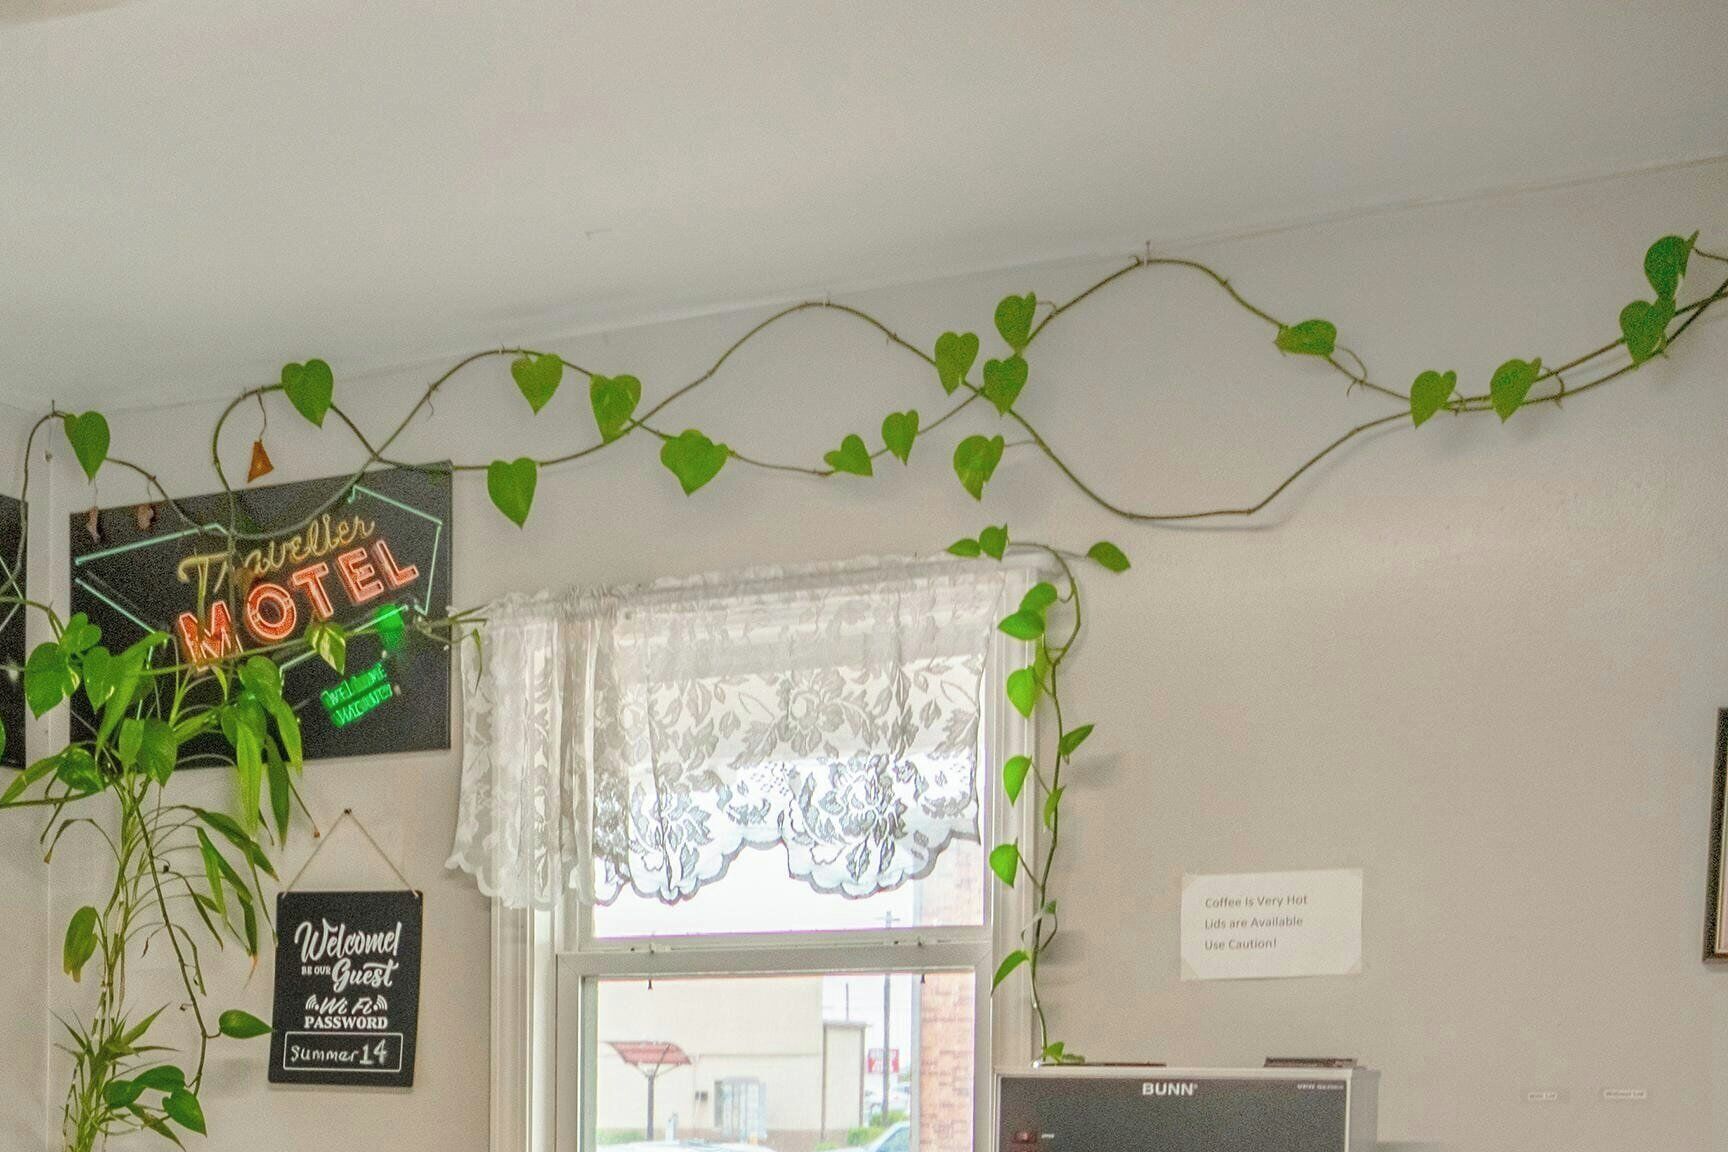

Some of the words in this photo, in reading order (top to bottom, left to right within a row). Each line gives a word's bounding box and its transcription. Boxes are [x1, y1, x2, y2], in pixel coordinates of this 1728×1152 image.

[178, 540, 420, 672] MOTEL
[1205, 897, 1242, 909] Coffee
[1256, 895, 1284, 908] Very
[1287, 894, 1308, 906] Hot
[1204, 917, 1226, 930] Lids
[1229, 920, 1248, 929] are
[1251, 915, 1304, 929] Available
[1204, 939, 1225, 951] Use
[1228, 937, 1278, 951] Caution!
[301, 965, 312, 976] BE
[313, 965, 331, 976] OUR
[332, 957, 399, 993] Guest
[304, 1015, 388, 1030] PASSWORD
[1142, 1082, 1194, 1096] BUNN
